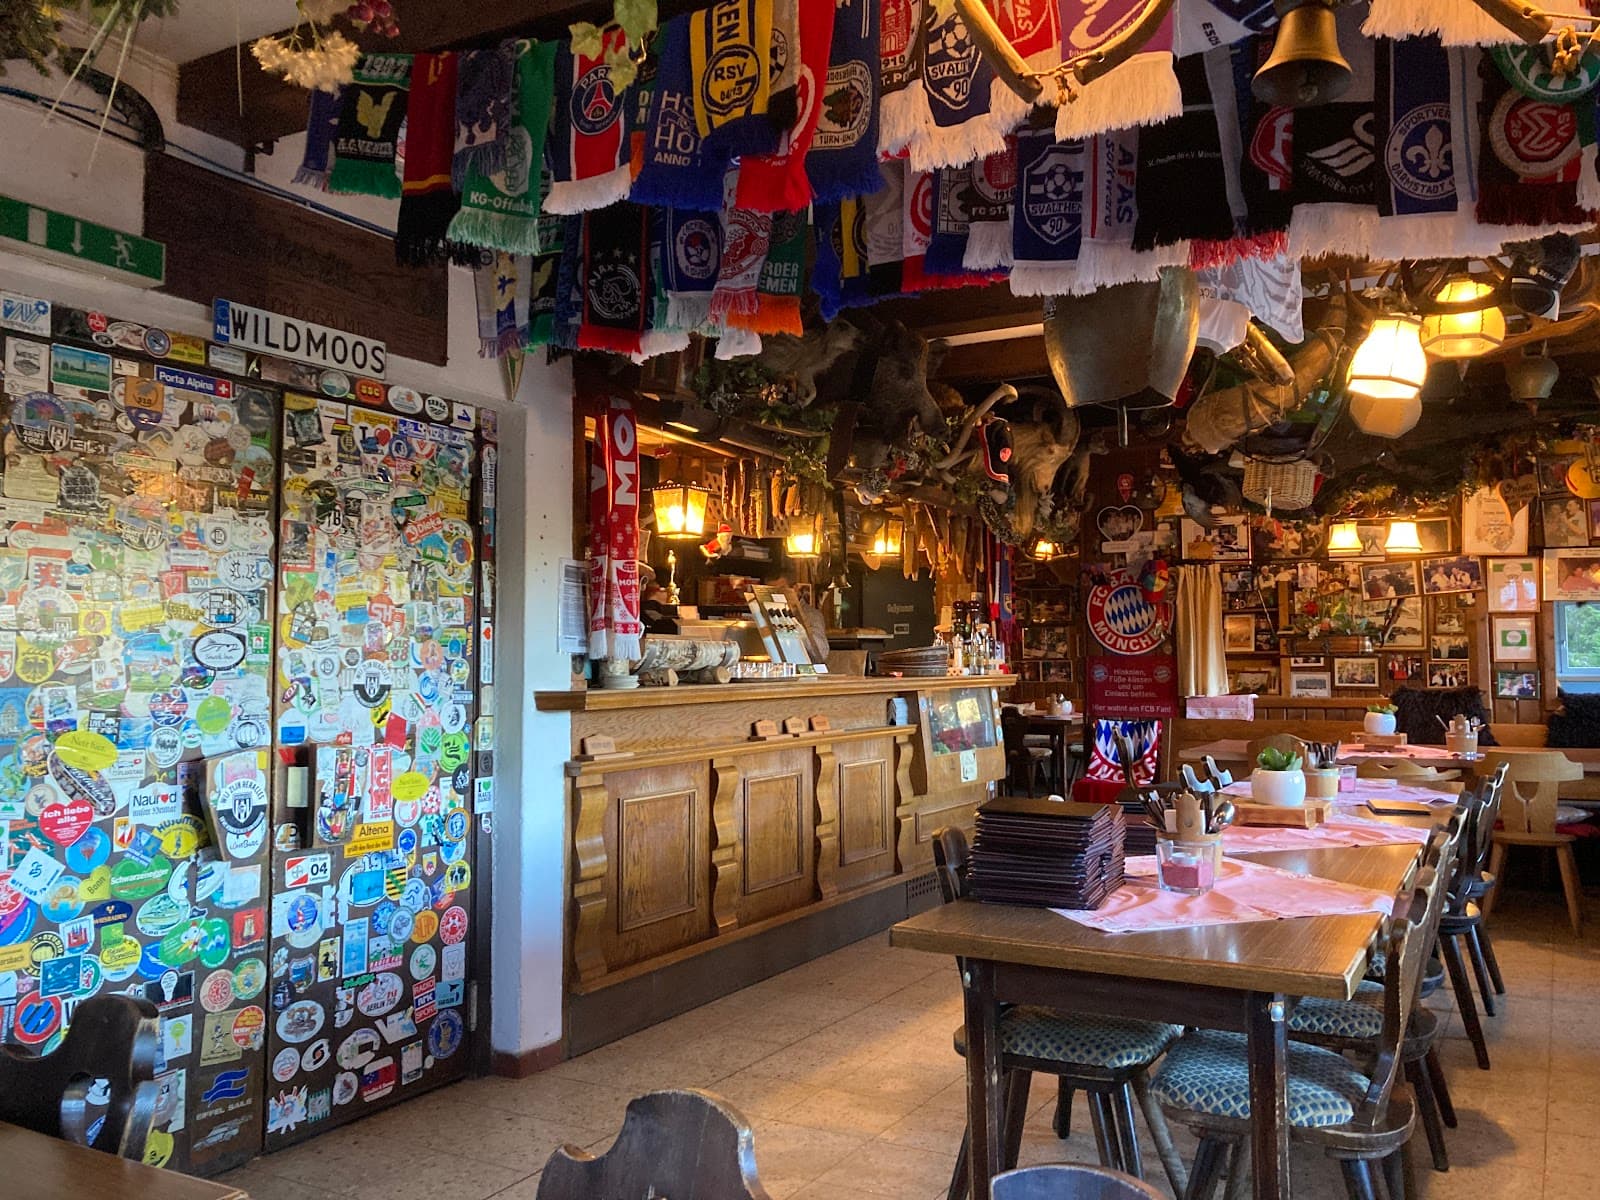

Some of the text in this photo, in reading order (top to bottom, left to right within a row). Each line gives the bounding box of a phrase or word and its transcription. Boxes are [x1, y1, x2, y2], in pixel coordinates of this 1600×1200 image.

[580, 66, 609, 88] PAR
[714, 62, 747, 82] RSV
[953, 80, 968, 98] 90
[1556, 111, 1569, 138] SV
[654, 151, 691, 167] ANNO
[1117, 146, 1136, 224] AFAS
[1391, 163, 1447, 195] DARMSTADT
[1048, 218, 1064, 234] 90
[216, 325, 230, 336] NL
[231, 307, 385, 374] WILDMOOS
[159, 370, 214, 391] Porta Alpina
[1092, 585, 1109, 607] FC
[1092, 703, 1105, 711] Hier
[1140, 705, 1155, 713] FCB
[1156, 705, 1171, 713] Fan!
[133, 792, 177, 807] Naurd
[44, 804, 91, 818] Ich liebe
[57, 815, 77, 825] alle
[359, 825, 389, 837] Altena
[311, 862, 328, 876] 04
[414, 979, 435, 994] RADIO
[366, 1002, 385, 1012] BERLIN
